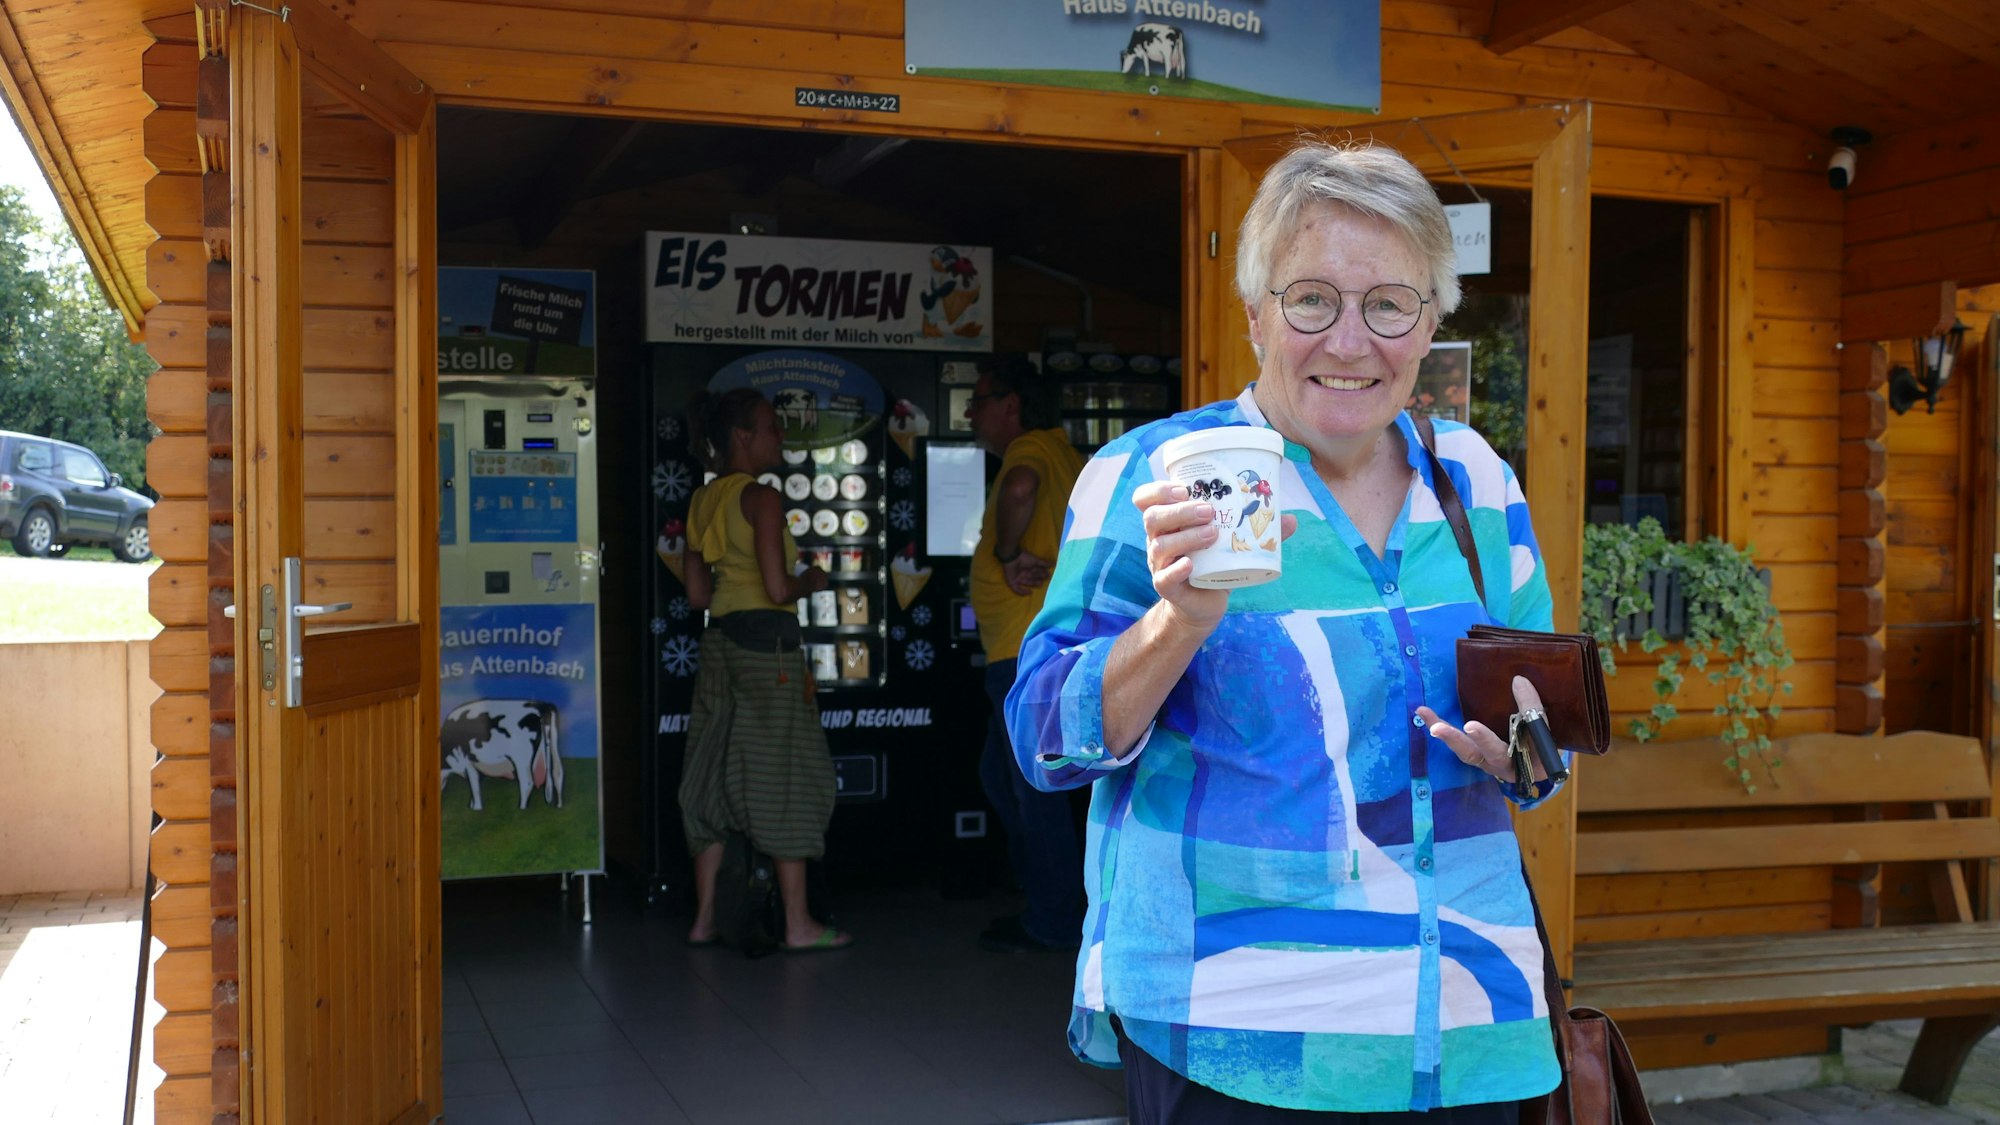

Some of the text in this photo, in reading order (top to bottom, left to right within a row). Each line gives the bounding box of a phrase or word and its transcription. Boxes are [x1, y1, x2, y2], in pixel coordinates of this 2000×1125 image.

[1063, 0, 1261, 33] Haus Attenbach
[655, 237, 727, 291] EIS
[500, 283, 582, 309] Frische Milch
[734, 264, 912, 322] TORMEN
[512, 302, 563, 320] rund um
[513, 319, 558, 335] die Uhr
[674, 323, 914, 344] hergestellt mit der Milch von
[438, 347, 514, 370] stelle
[745, 357, 846, 378] Milchtankstelle
[751, 371, 841, 390] Haus Attenbach
[440, 623, 564, 647] auernhof
[440, 655, 585, 680] us Attenbach
[657, 707, 933, 735] NAT UND REGIONAL
